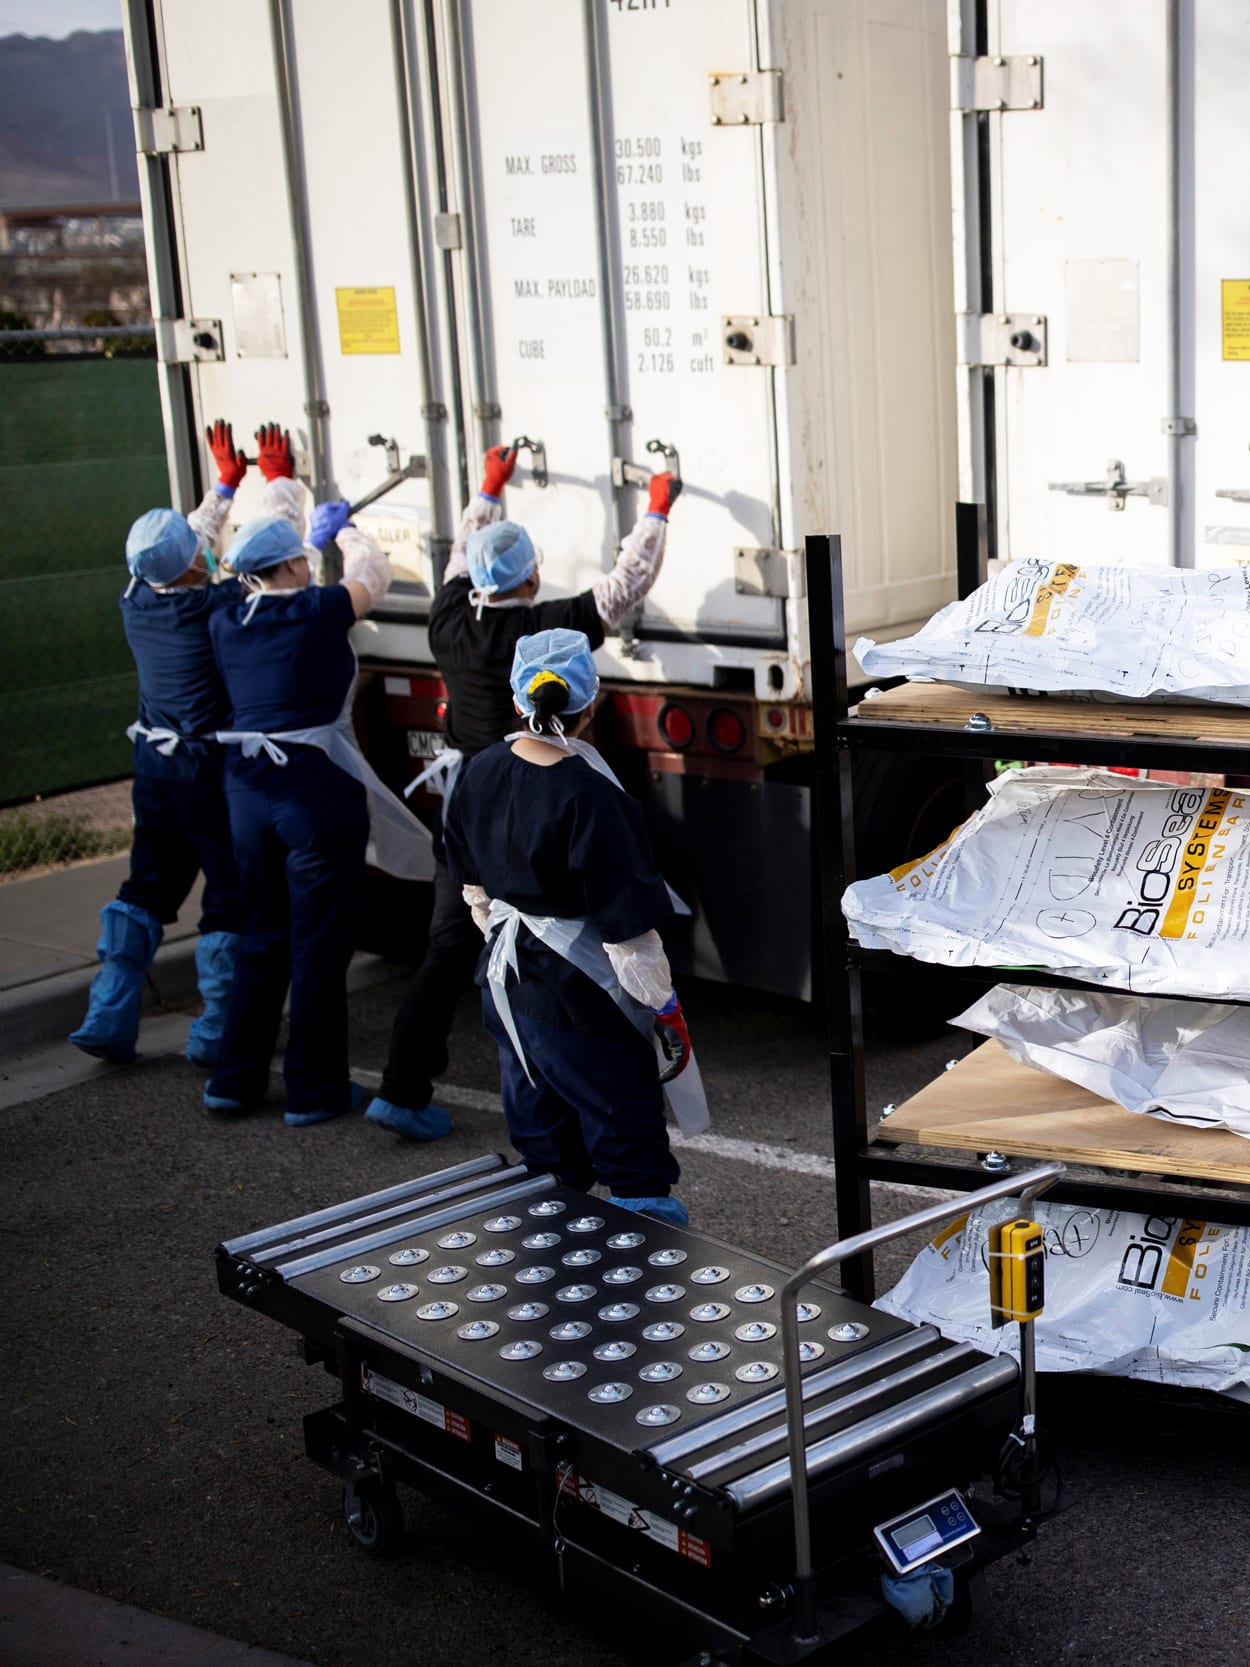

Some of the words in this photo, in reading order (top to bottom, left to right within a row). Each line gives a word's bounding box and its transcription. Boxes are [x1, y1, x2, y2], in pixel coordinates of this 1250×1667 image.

[681, 136, 703, 160] kgs
[505, 155, 535, 176] MAX.
[541, 154, 576, 174] GROSS
[617, 164, 663, 184] 67.240
[682, 163, 701, 182] lbs
[628, 202, 665, 221] 3.880
[684, 201, 706, 224] kgs
[510, 218, 536, 238] TARE
[630, 228, 666, 248] 8.550
[686, 227, 704, 247] lbs
[623, 265, 669, 285] 26.620
[688, 265, 710, 286] kgs
[515, 279, 545, 299] MAX.
[548, 279, 596, 299] PAYLOAD
[625, 291, 671, 311] 58.690
[690, 291, 708, 311] lbs
[644, 328, 673, 347] 60.2
[518, 339, 546, 359] CUBE
[638, 354, 675, 374] 2.126
[690, 354, 714, 374] cuft
[1098, 839, 1110, 856] Level
[1106, 797, 1124, 833] Containment
[1209, 1297, 1219, 1321] Secure
[1214, 1252, 1228, 1296] Containment
[1221, 1238, 1230, 1251] For:
[1115, 1284, 1183, 1303] www.BioSeal.com
